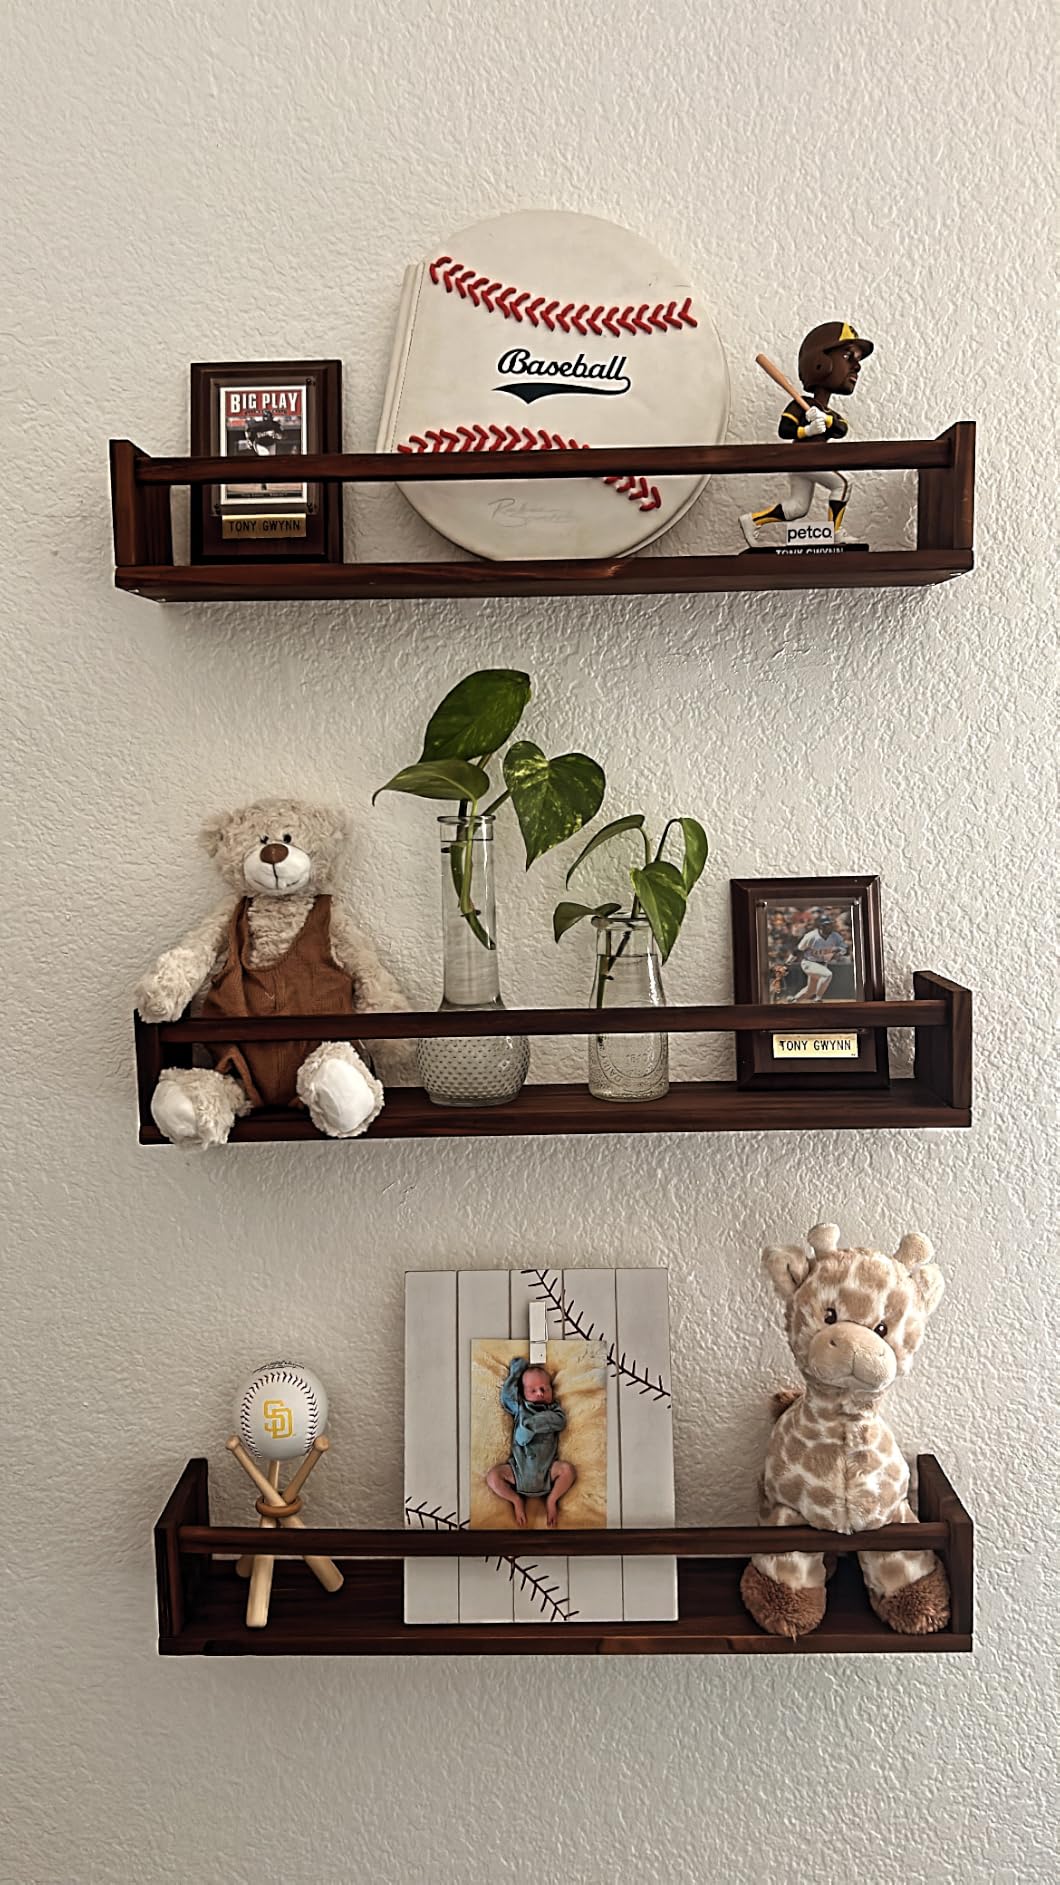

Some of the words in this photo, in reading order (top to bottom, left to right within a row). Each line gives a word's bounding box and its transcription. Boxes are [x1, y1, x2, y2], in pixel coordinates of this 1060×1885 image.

[498, 348, 631, 382] Baseball
[230, 393, 257, 413] BIG
[262, 392, 298, 412] PLAY
[229, 521, 256, 532] TONY
[262, 520, 300, 531] GWYNN
[787, 525, 832, 543] petco
[779, 1040, 808, 1051] TONY
[813, 1040, 851, 1051] GWYNN
[263, 1400, 293, 1439] SD
